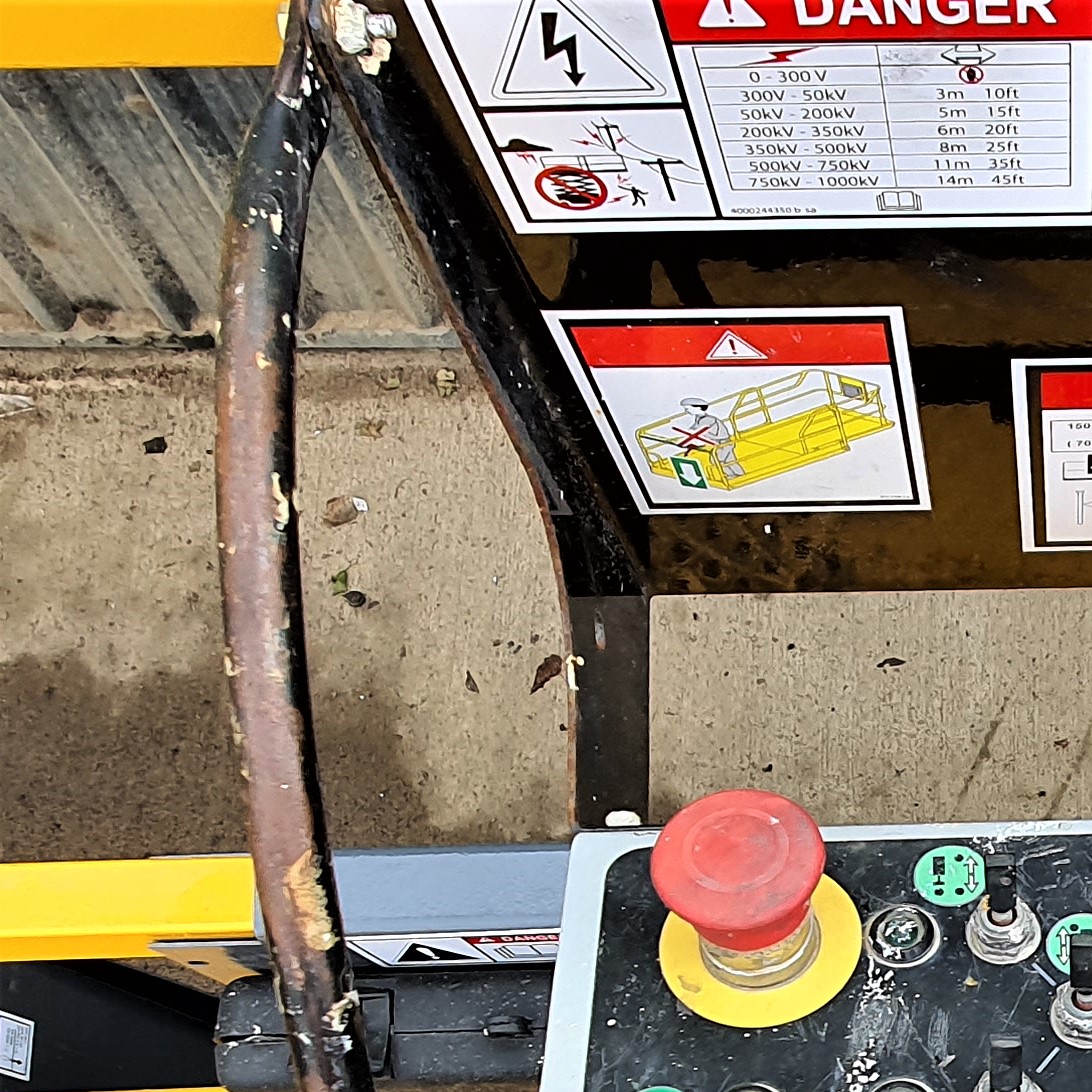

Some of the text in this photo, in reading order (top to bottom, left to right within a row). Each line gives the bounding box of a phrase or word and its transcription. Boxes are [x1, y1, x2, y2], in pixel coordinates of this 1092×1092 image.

[793, 0, 1057, 25] DANGER
[749, 71, 761, 83] 0
[778, 70, 811, 83] 300
[814, 70, 828, 82] V
[740, 89, 785, 102] 300V
[802, 88, 847, 102] 50kV
[935, 87, 1020, 100] 3m 10ft
[740, 107, 784, 121] 50kV
[801, 107, 856, 120] 200kV
[938, 105, 1021, 119] 5m 15ft
[740, 125, 794, 138] 200kV
[811, 125, 865, 138] 350kV
[937, 123, 1019, 136] 6m 20ft
[744, 143, 798, 156] 350kV
[814, 142, 868, 155] 500kV
[939, 140, 1020, 153] 8m 25ft
[749, 160, 802, 173] 500kV
[817, 159, 871, 172] 750kV
[934, 158, 1022, 170] 11m 35ft
[748, 176, 801, 188] 750kV
[818, 175, 879, 187] 1000kV
[937, 174, 1025, 186] 14m 45ft
[1067, 422, 1091, 430] 150
